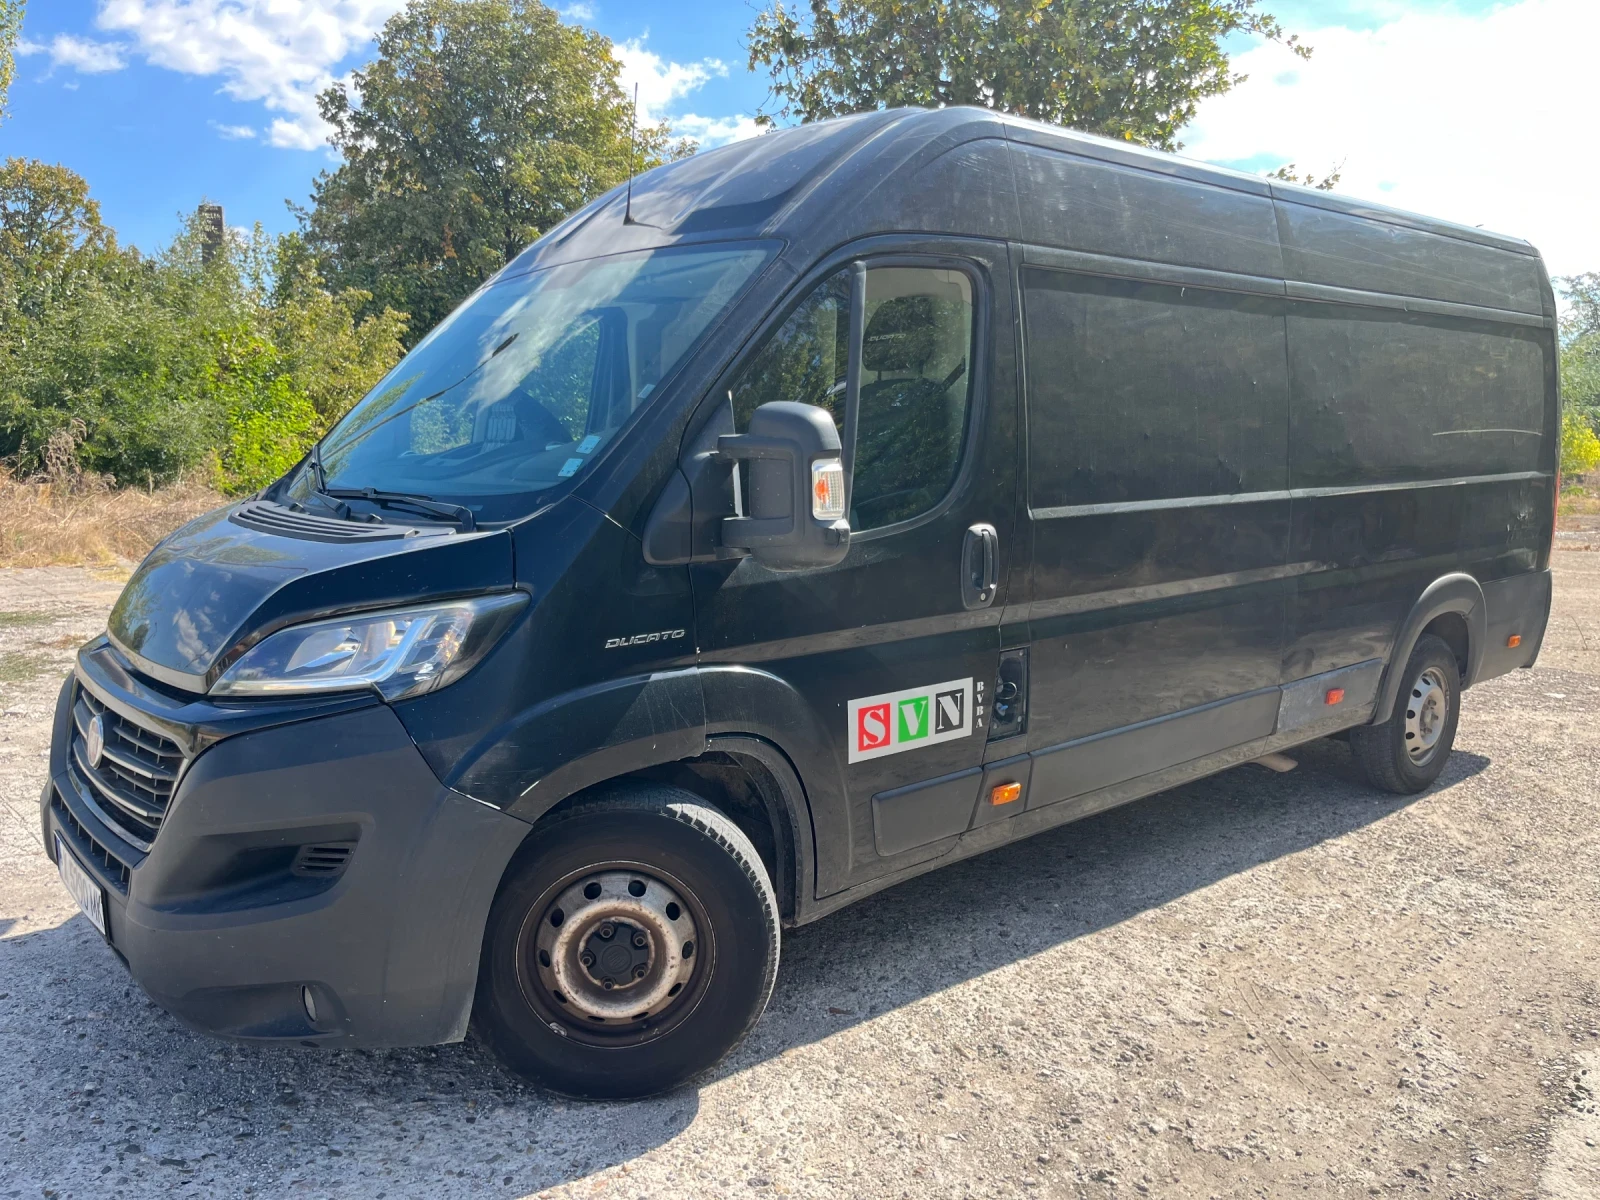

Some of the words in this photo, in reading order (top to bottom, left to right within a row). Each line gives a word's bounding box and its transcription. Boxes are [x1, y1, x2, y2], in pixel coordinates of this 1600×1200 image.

[604, 629, 686, 649] DUCATO
[862, 692, 963, 747] SVN
[975, 681, 985, 729] BVBA
